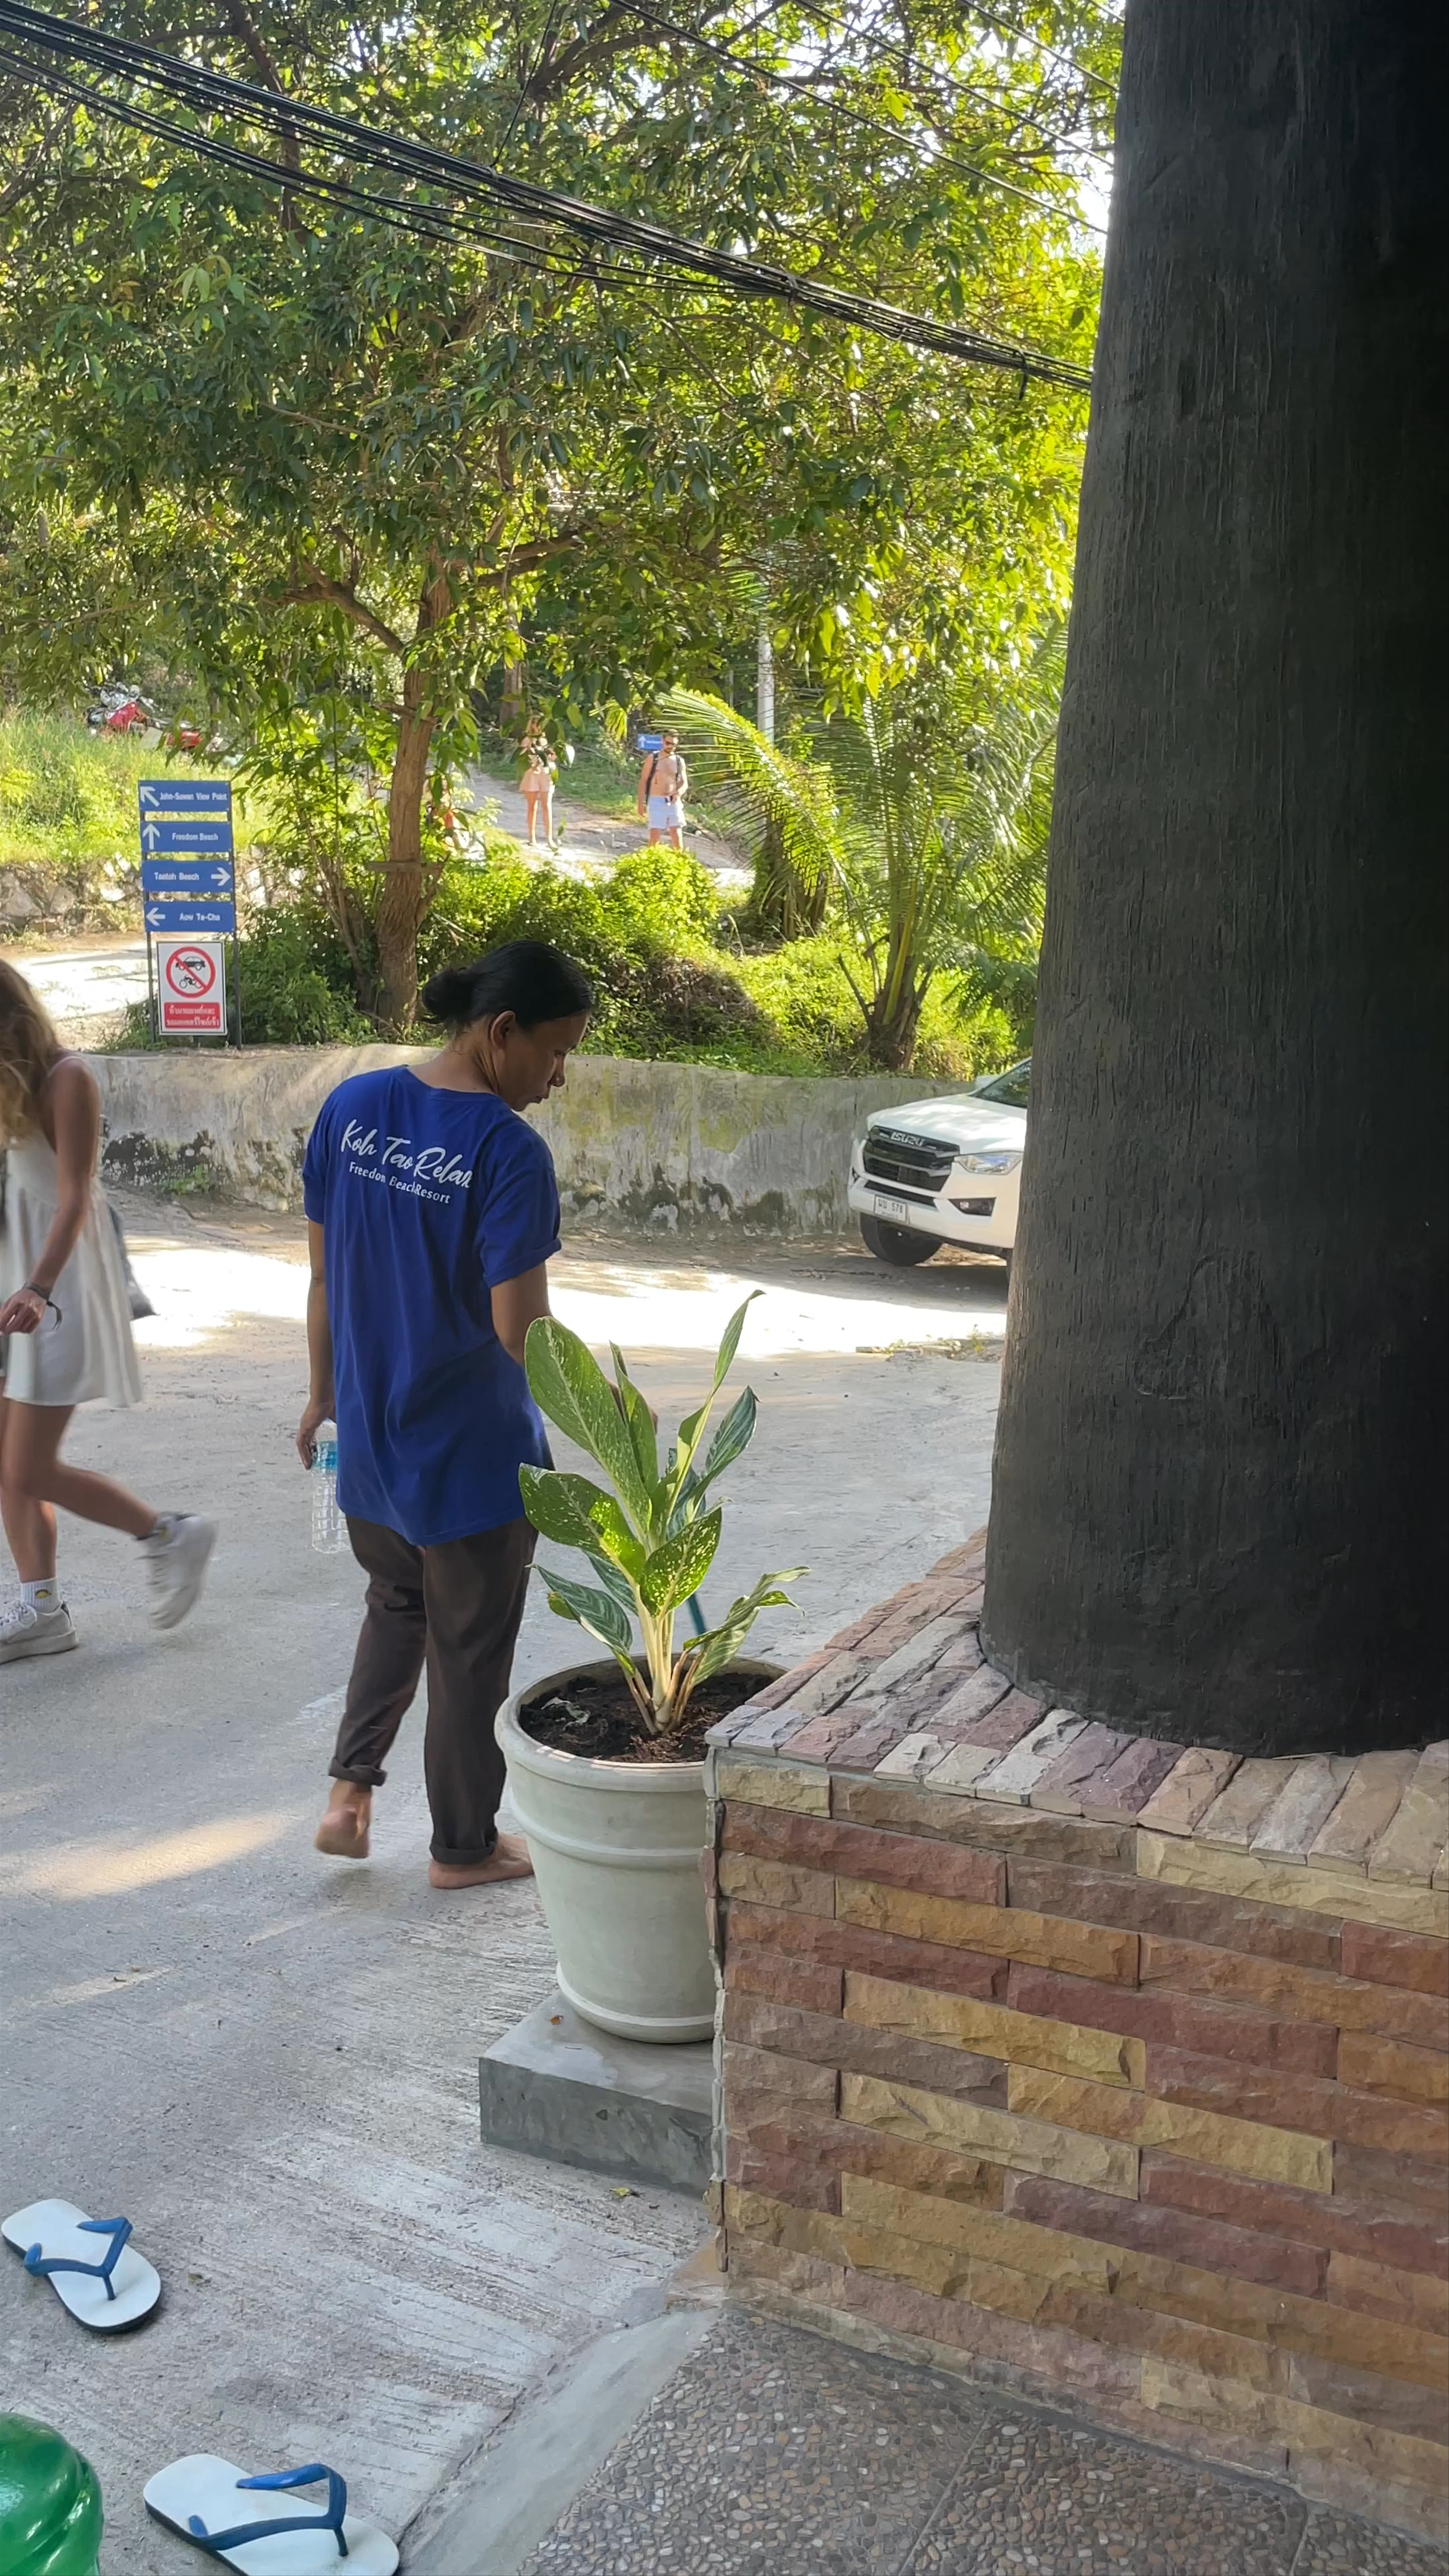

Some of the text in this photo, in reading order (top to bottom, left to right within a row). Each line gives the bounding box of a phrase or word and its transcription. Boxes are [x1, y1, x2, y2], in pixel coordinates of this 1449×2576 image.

[172, 832, 198, 841] Freedom
[179, 872, 199, 880] Beach
[891, 1132, 924, 1147] ISUZU
[341, 1119, 473, 1188] Koh Tao Relax
